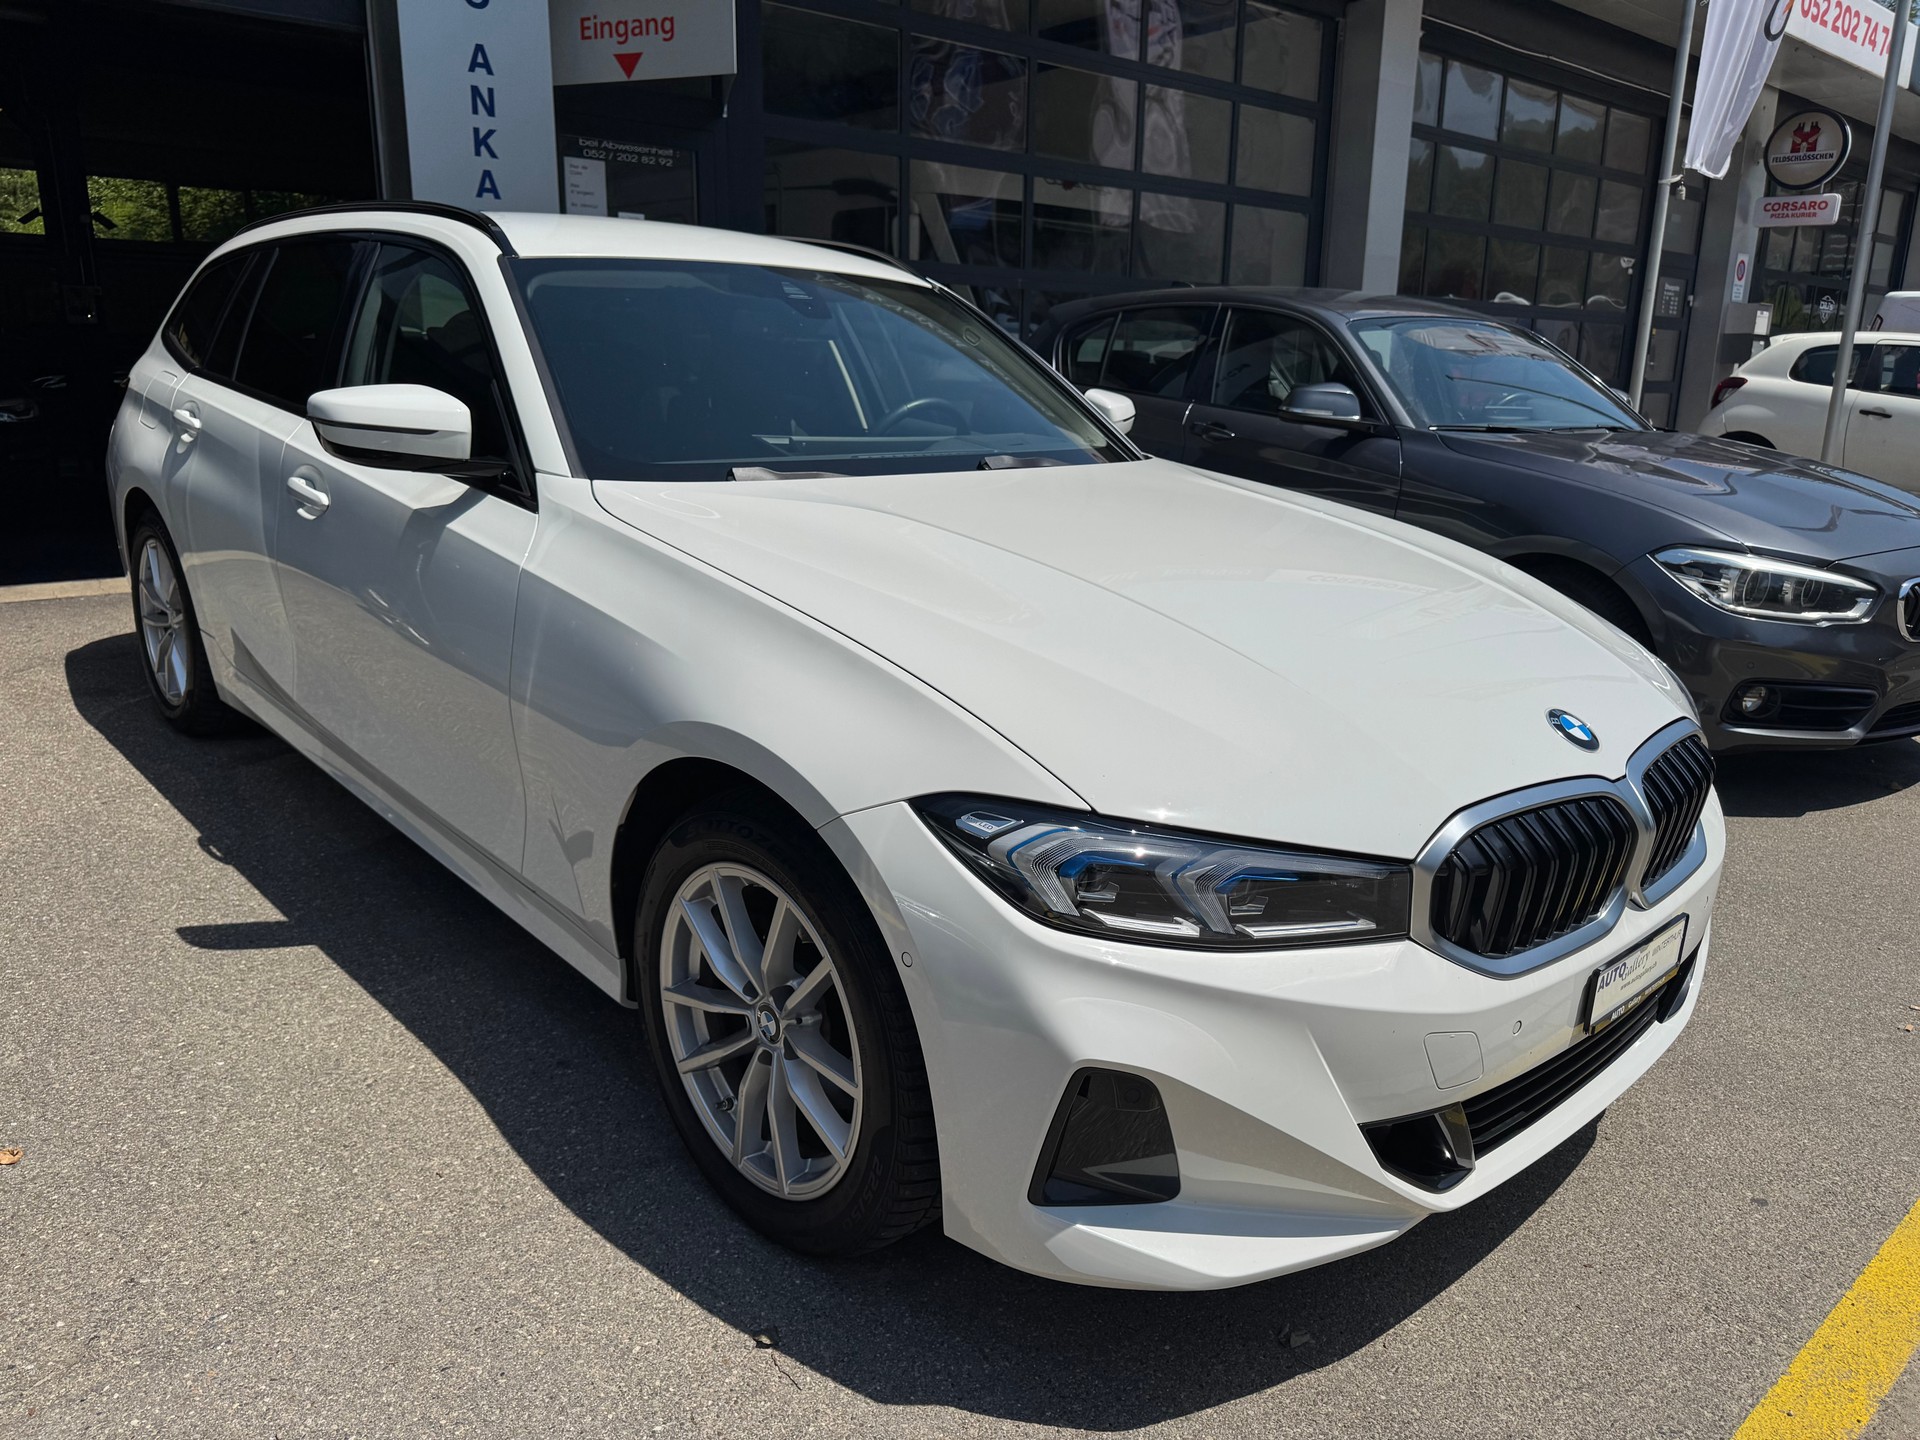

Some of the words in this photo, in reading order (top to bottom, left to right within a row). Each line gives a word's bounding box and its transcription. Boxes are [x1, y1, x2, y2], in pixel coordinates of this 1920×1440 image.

[579, 15, 676, 45] Eingang
[1831, 0, 1861, 43] 202
[1861, 15, 1879, 52] 74
[1879, 25, 1891, 56] 7
[467, 43, 502, 200] ANKA
[578, 138, 599, 148] bei
[582, 149, 606, 159] 052
[616, 152, 639, 163] 202
[658, 158, 673, 168] 92
[1771, 152, 1835, 163] FELDSCHLÖSSCHEN
[1763, 200, 1829, 212] CORSARO
